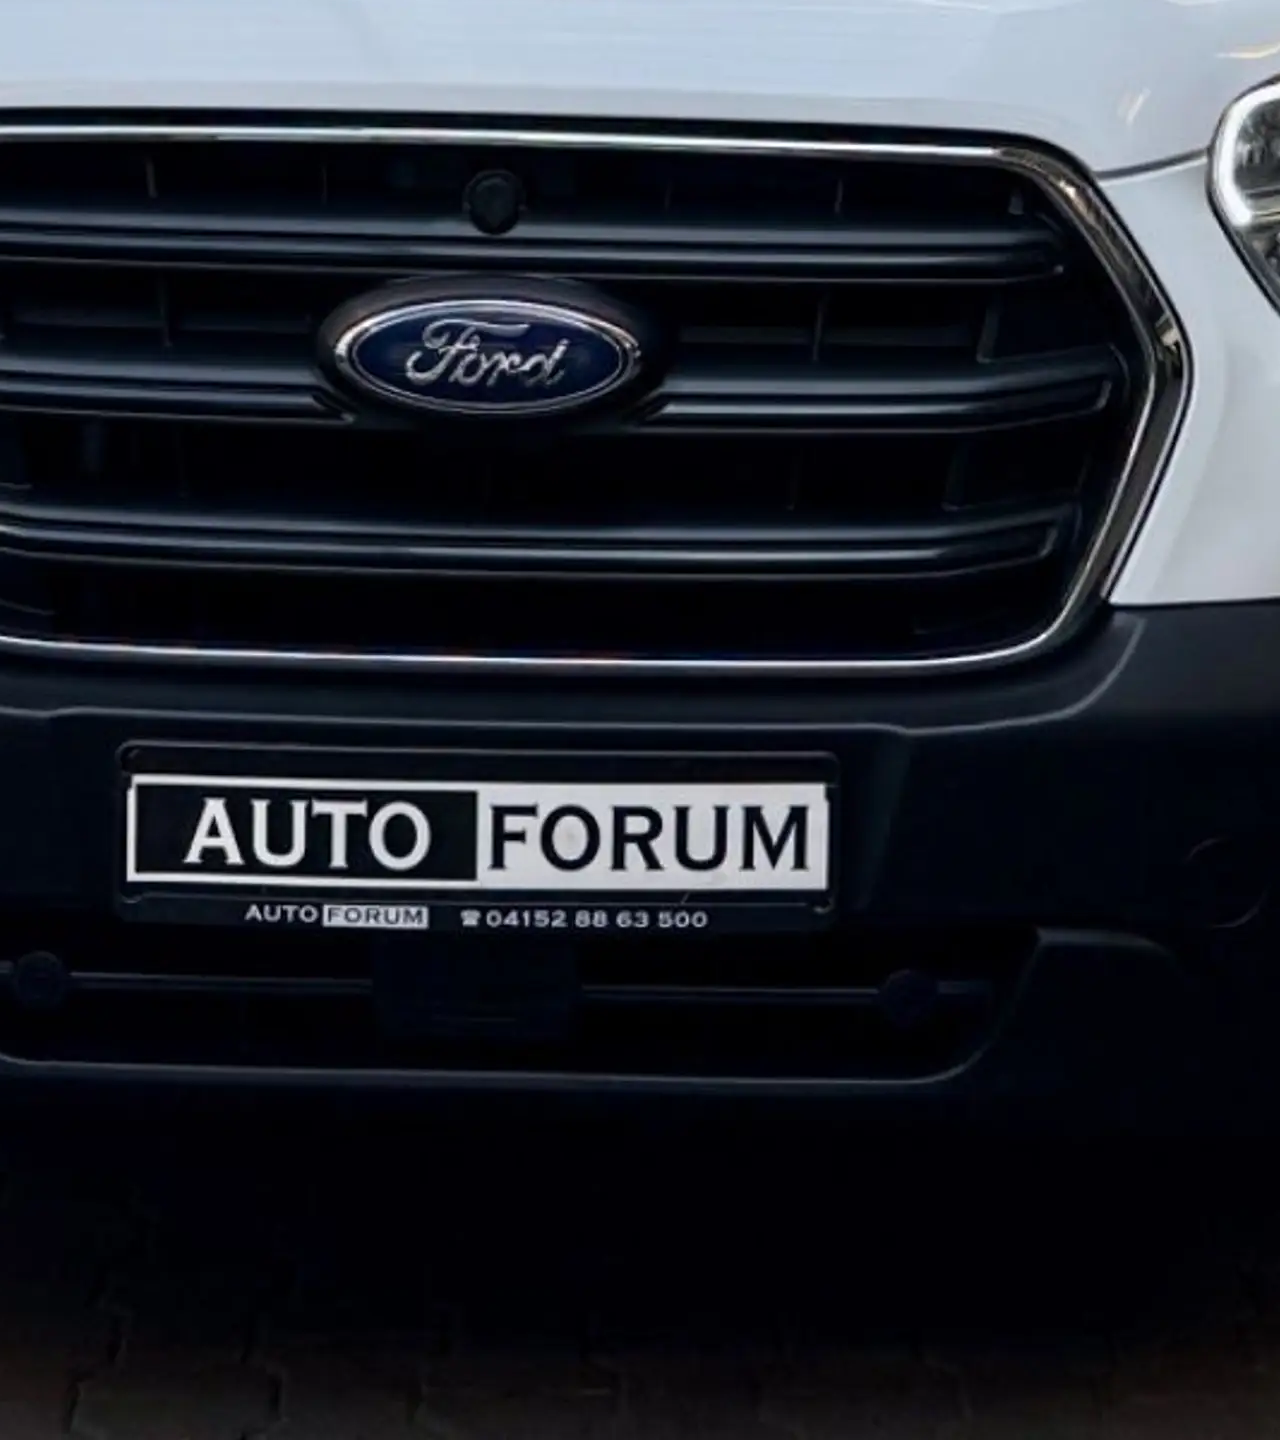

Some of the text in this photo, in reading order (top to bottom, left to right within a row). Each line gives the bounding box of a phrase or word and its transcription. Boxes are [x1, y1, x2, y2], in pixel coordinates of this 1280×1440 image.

[405, 318, 571, 387] Ford
[182, 796, 811, 873] AUTO FORUM
[244, 903, 424, 925] AUTO FORUM
[486, 909, 709, 929] 04152 88 63 500
